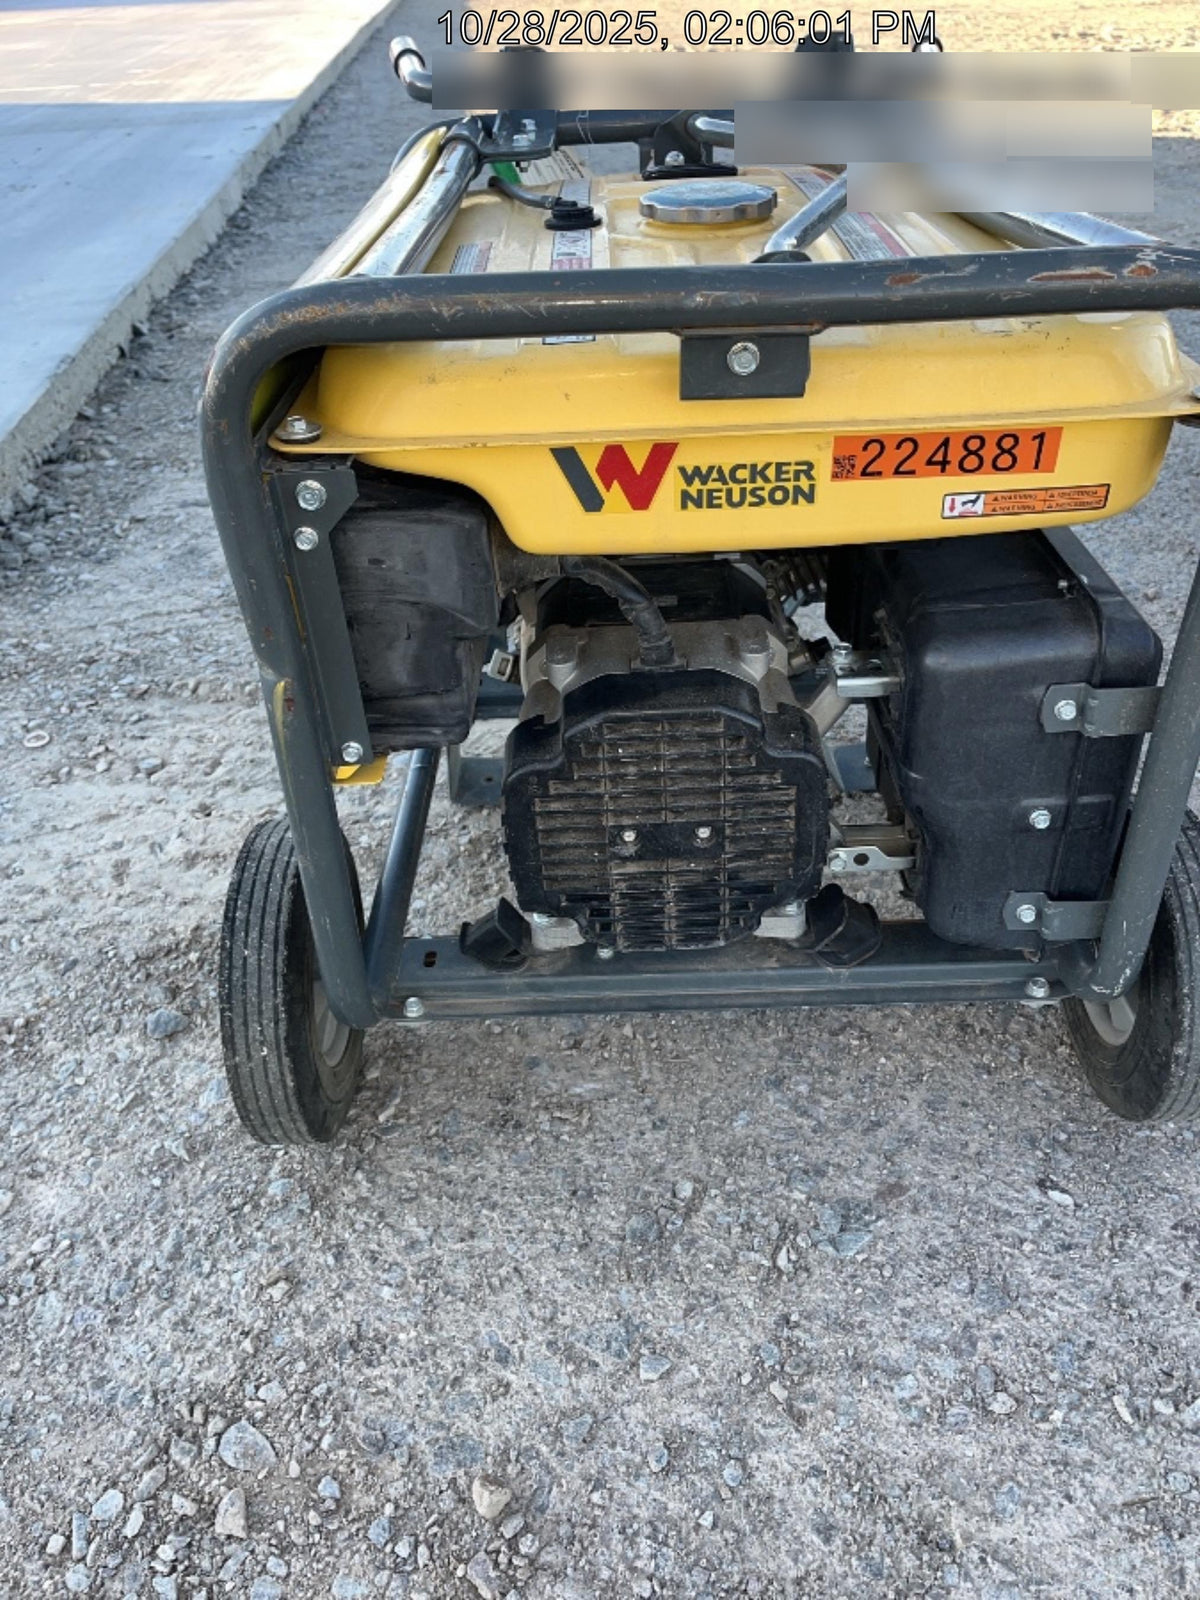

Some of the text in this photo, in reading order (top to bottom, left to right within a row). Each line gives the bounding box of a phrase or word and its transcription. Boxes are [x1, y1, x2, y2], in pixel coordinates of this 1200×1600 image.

[860, 431, 1047, 477] 224881
[677, 460, 816, 487] WACKER
[680, 483, 815, 510] NEUSON
